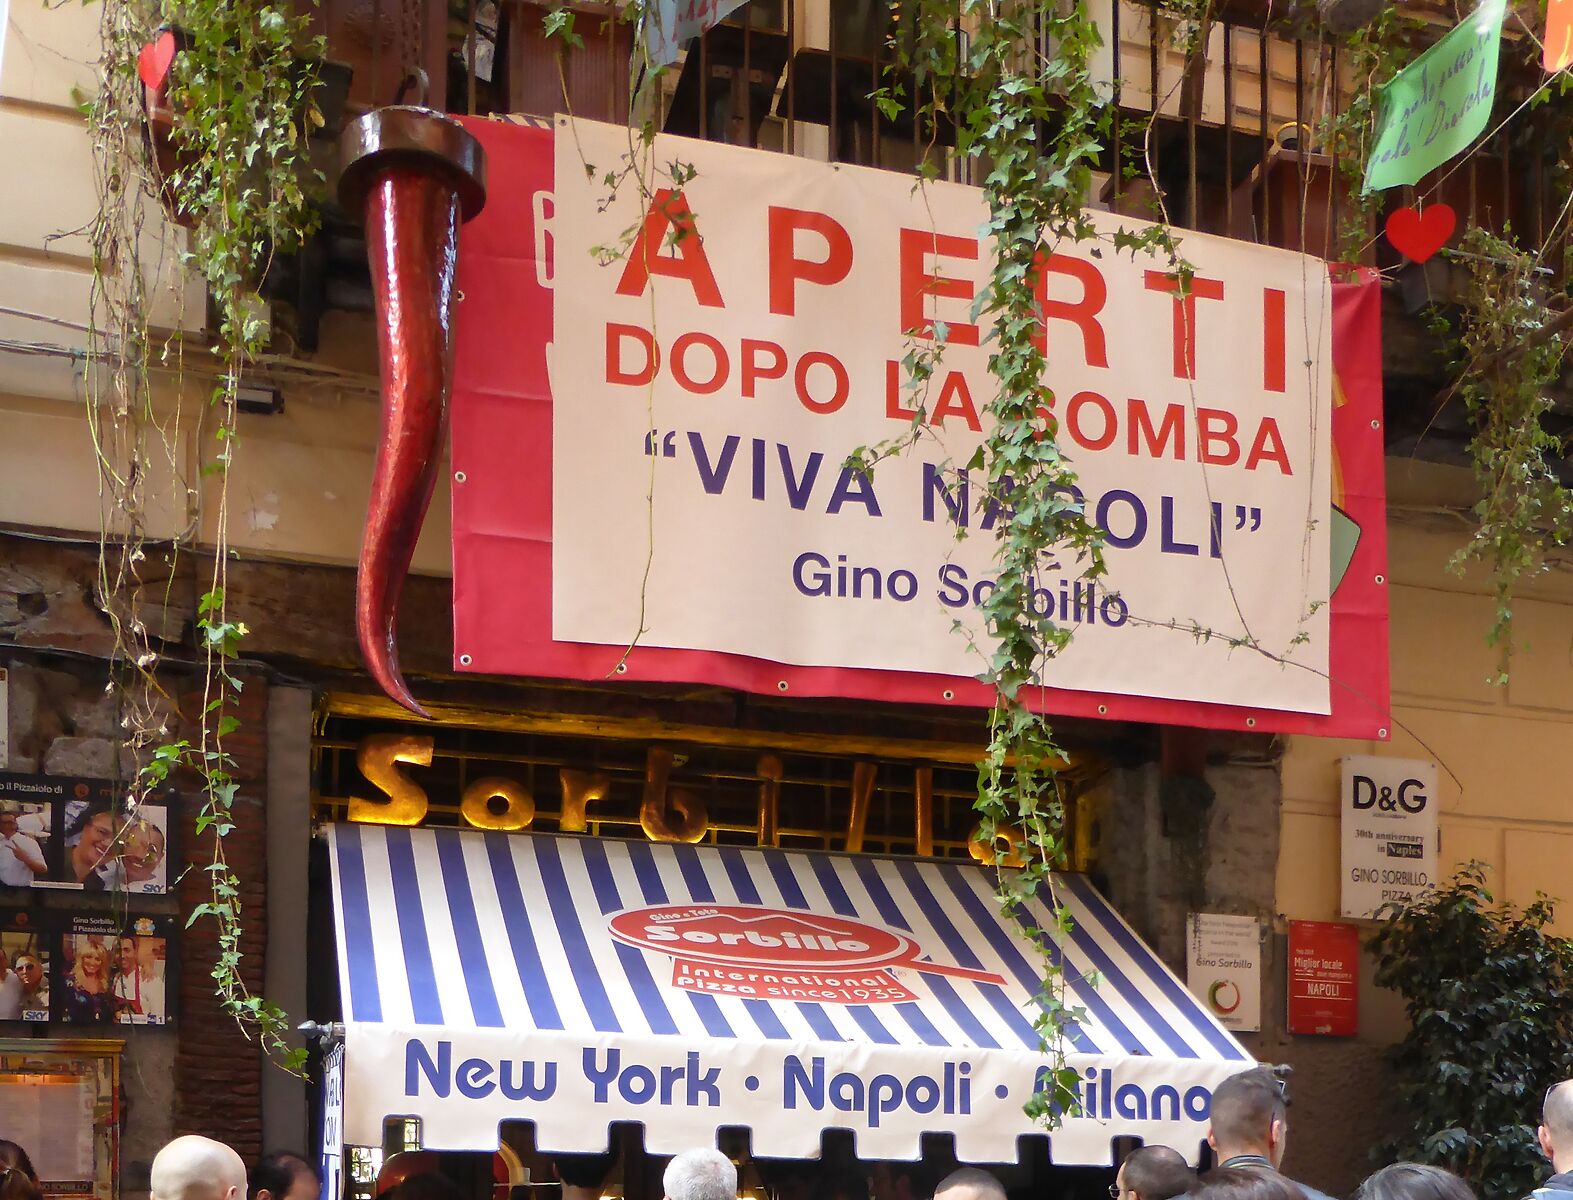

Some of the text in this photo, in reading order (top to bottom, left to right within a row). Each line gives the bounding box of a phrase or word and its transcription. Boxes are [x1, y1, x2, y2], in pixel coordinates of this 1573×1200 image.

[616, 188, 1286, 392] APERTI
[606, 322, 850, 415] DOPO
[885, 360, 983, 433] LA
[792, 552, 1129, 628] Gino Sobillo
[13, 783, 53, 794] Pizzaiolo
[1353, 775, 1427, 814] D&G
[347, 733, 1030, 868] Sorbillo
[1375, 832, 1424, 845] anniversary
[1351, 867, 1428, 887] GINO SORBILLO
[649, 913, 681, 921] Gino
[645, 924, 870, 952] Sorbillo
[1196, 958, 1253, 969] Gino Sorbillo
[1294, 956, 1343, 970] Miglior locale
[677, 976, 756, 995] Pizza
[681, 963, 888, 987] International
[1307, 983, 1340, 997] NAPOLI
[405, 1038, 558, 1102] New
[582, 1048, 722, 1107] York
[783, 1054, 972, 1128] Napoli
